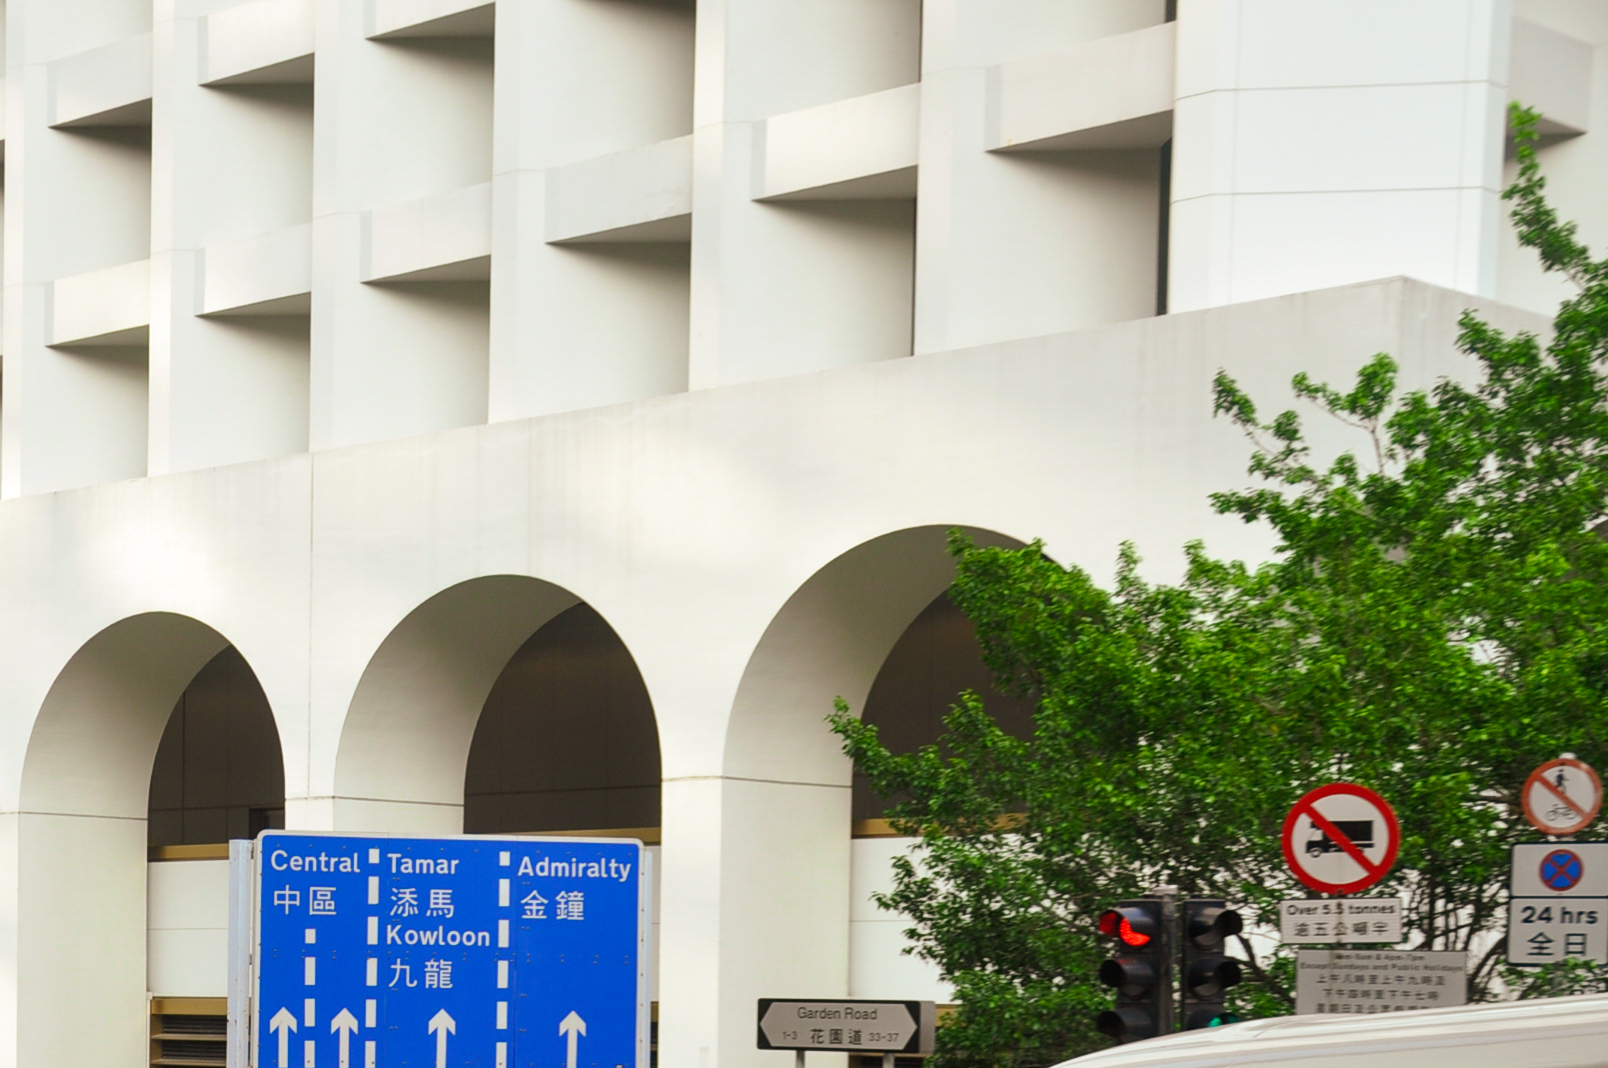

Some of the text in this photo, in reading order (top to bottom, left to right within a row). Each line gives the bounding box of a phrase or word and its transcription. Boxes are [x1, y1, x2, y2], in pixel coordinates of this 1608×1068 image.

[271, 850, 361, 873] Central
[387, 853, 460, 875] Tamar
[517, 855, 631, 882] Admiralty
[273, 884, 337, 916] 中區
[390, 887, 455, 919] 添馬
[520, 890, 585, 921] 金鐘
[1286, 904, 1318, 915] Over
[1521, 906, 1599, 924] 24 hrs
[387, 925, 491, 947] Kowloon
[1526, 931, 1587, 956] 全日
[388, 958, 453, 989] 九龍
[797, 1006, 878, 1021] Garden Road
[810, 1028, 863, 1045] 花園道
[868, 1032, 900, 1043] 33-37
